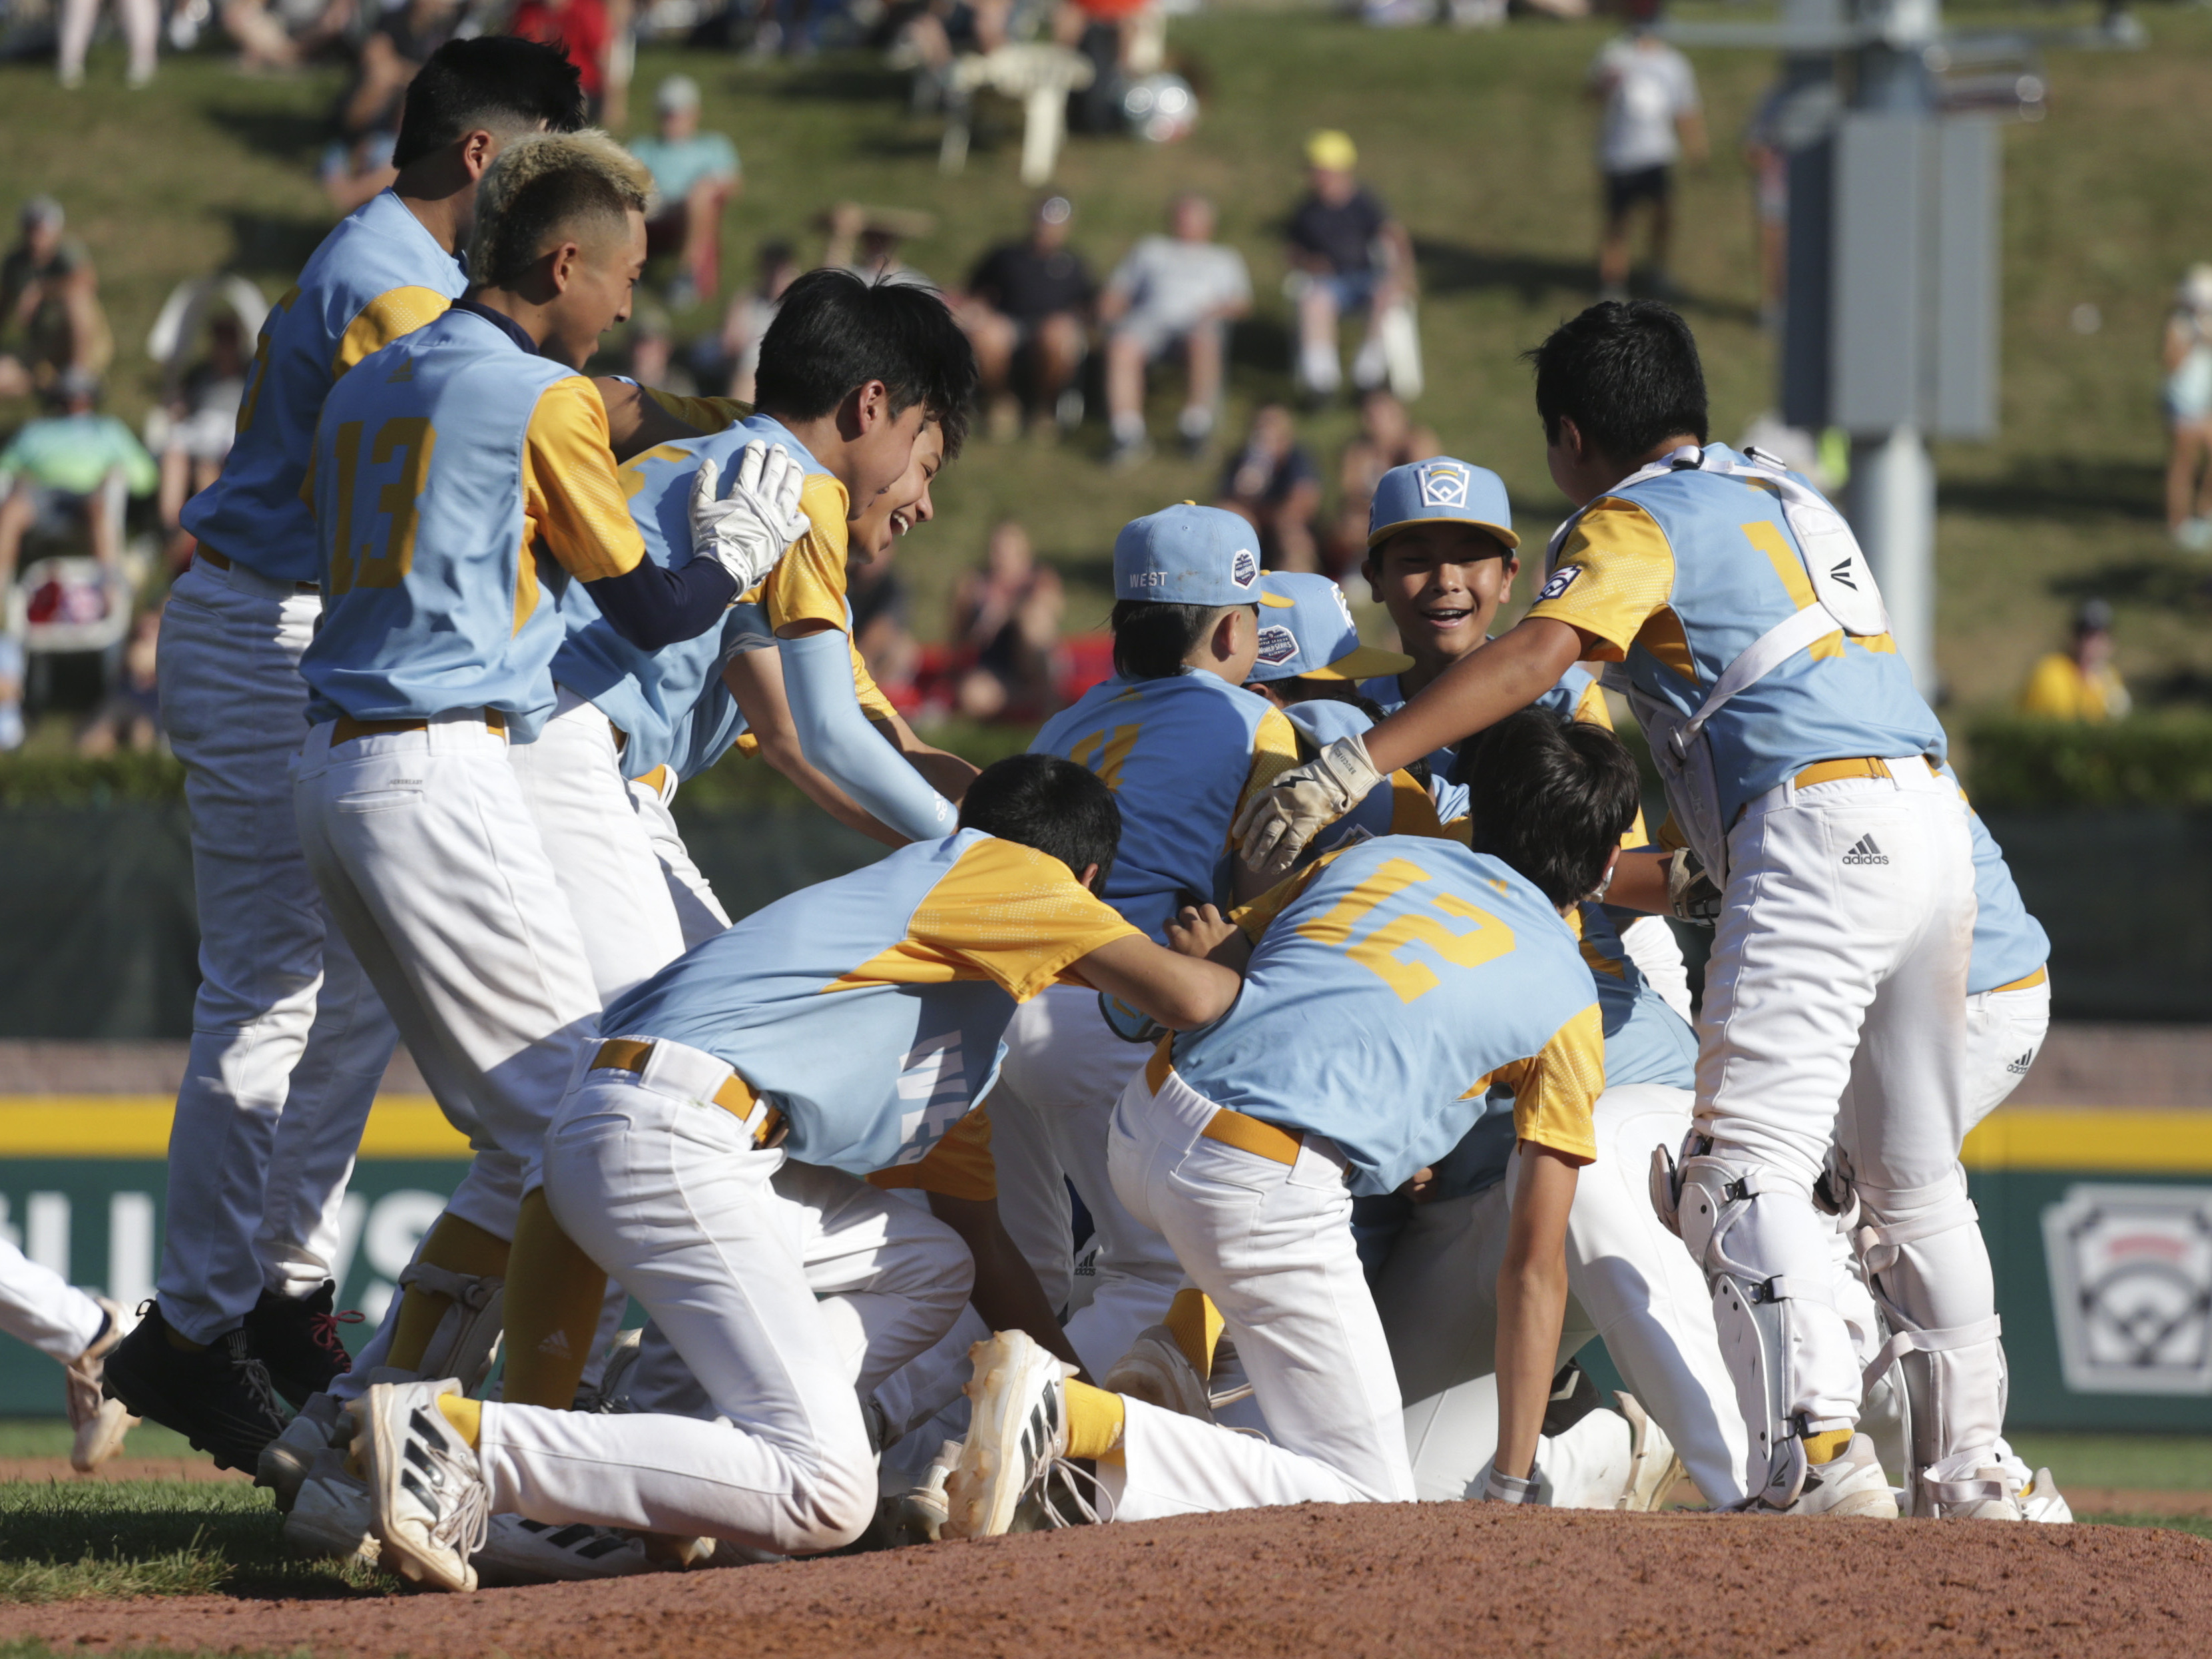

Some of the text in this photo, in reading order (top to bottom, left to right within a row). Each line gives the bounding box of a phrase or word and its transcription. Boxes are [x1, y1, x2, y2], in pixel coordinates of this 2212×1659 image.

[330, 416, 437, 596] 13
[1130, 571, 1167, 587] WEST
[1842, 852, 1890, 865] adidas
[1294, 856, 1517, 1005] 12
